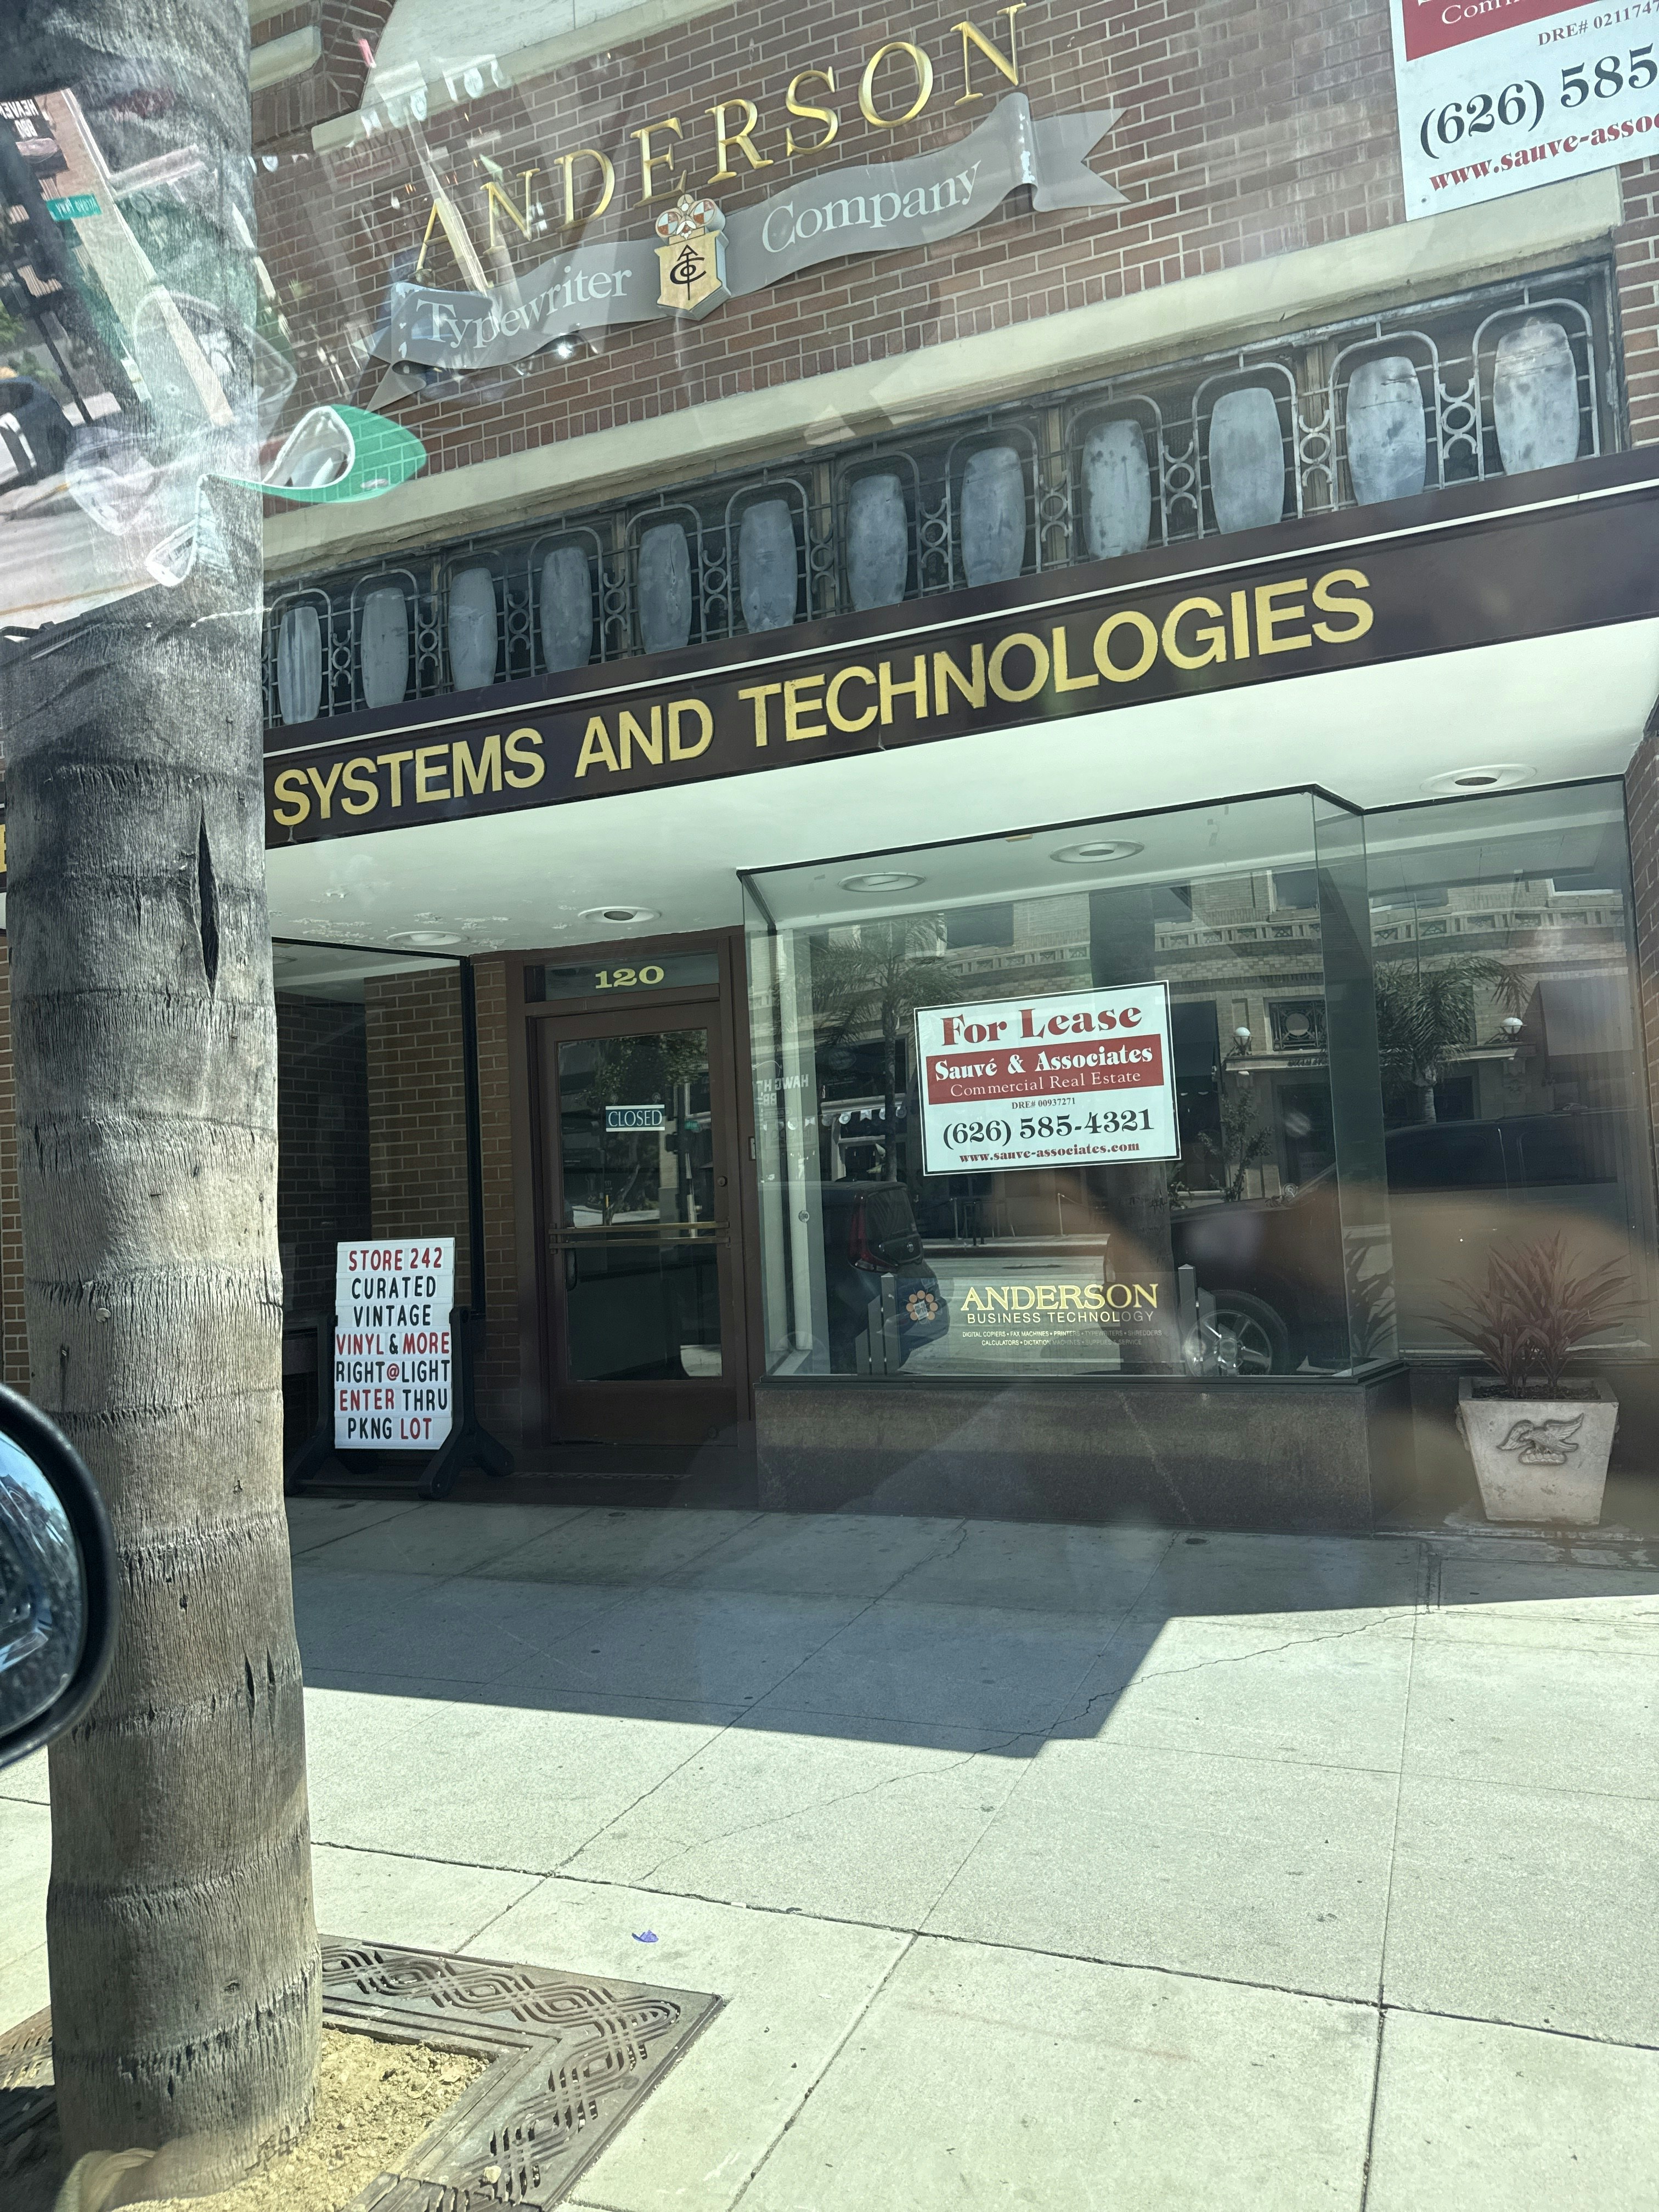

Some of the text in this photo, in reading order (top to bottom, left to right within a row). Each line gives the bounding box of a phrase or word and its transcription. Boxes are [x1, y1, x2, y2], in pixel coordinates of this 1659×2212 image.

[1538, 20, 1589, 46] DRE#
[1420, 80, 1545, 160] (626)
[408, 2, 1027, 288] ANDERSON
[416, 159, 982, 349] Typewriter Company
[273, 568, 1374, 826] SYSTEMS AND TECHNOLOGIES
[595, 966, 664, 989] 120
[941, 1007, 1143, 1046] For Lease
[935, 1044, 1153, 1082] Sauvé & Associates
[950, 1071, 1141, 1097] Commercial Real Estate
[1011, 1097, 1076, 1110] DRE# 00937271
[608, 1110, 663, 1127] CLOSED
[943, 1108, 1155, 1150] (626) 585-4321
[959, 1142, 1140, 1163] www.sauve-associates.com
[349, 1247, 443, 1271] STORE 242
[351, 1276, 437, 1300] CURATED
[961, 1283, 1159, 1311] ANDERSON
[353, 1304, 432, 1327] VINTAGE
[967, 1311, 1154, 1324] BUSINESS TECHNOLOGY
[336, 1331, 450, 1355] VINYL & MORE
[340, 1388, 448, 1411] ENTER THRU
[347, 1417, 432, 1440] PKNG LOT
